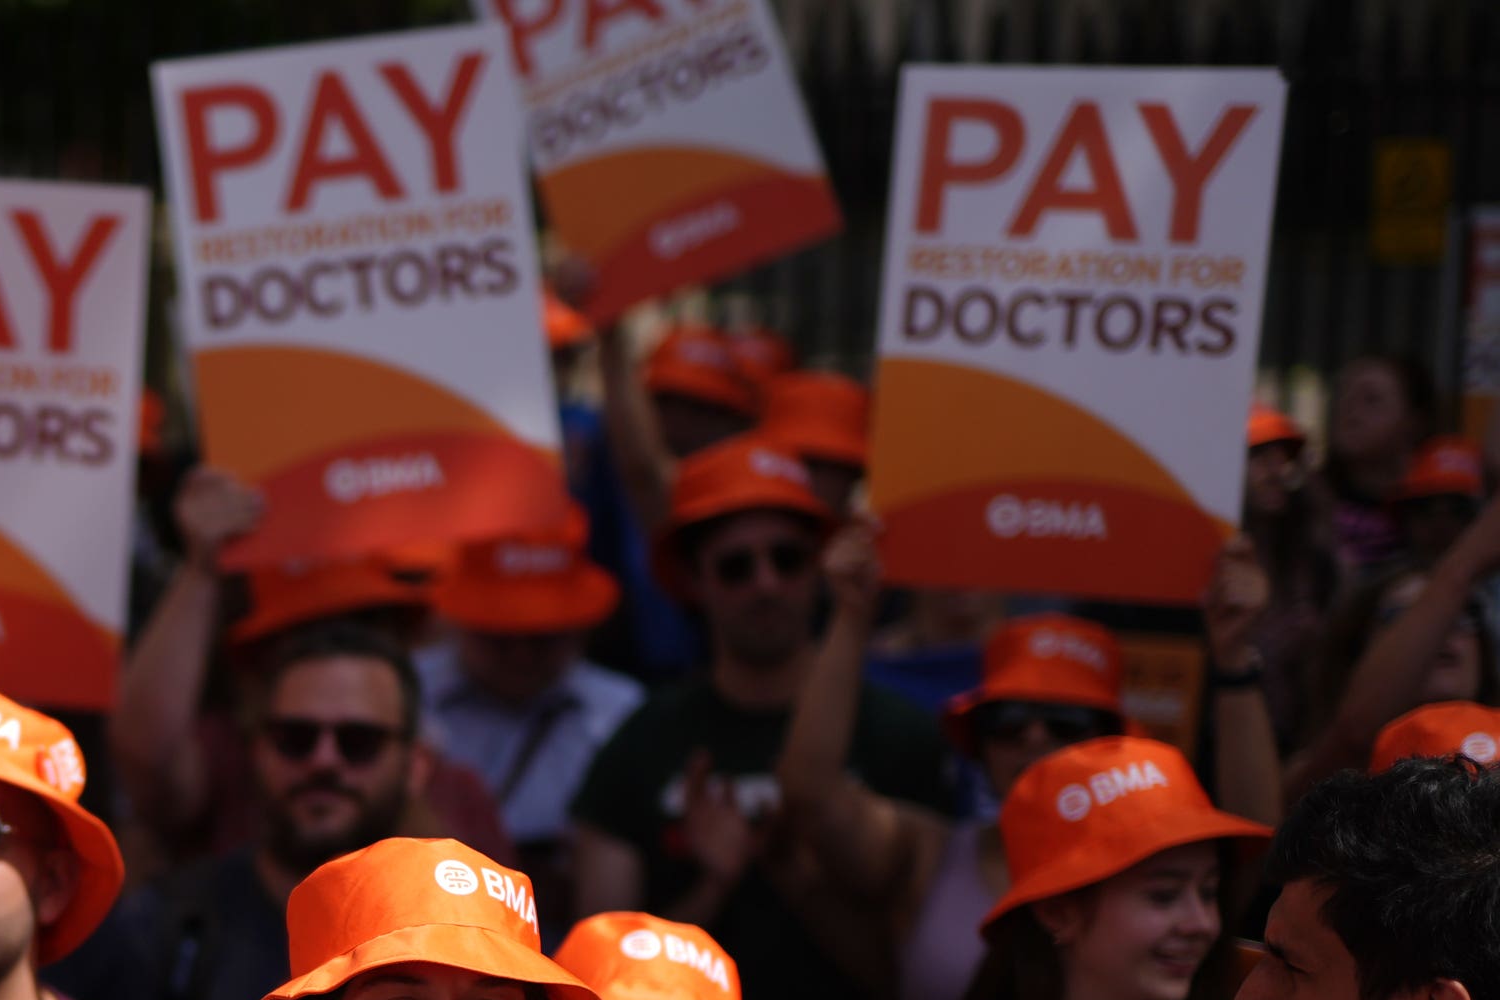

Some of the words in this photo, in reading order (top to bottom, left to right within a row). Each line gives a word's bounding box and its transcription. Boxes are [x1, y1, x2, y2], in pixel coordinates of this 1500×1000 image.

[182, 53, 484, 223] PAY
[915, 96, 1258, 243] PAY
[204, 240, 518, 329] DOCTORS
[908, 245, 1159, 283] RESTORATION
[1170, 255, 1244, 287] FOR
[903, 285, 1237, 357] DOCTORS
[1026, 499, 1106, 539] BMA
[1088, 760, 1169, 804] BMA
[480, 867, 538, 935] BMA
[665, 933, 729, 992] BMA
